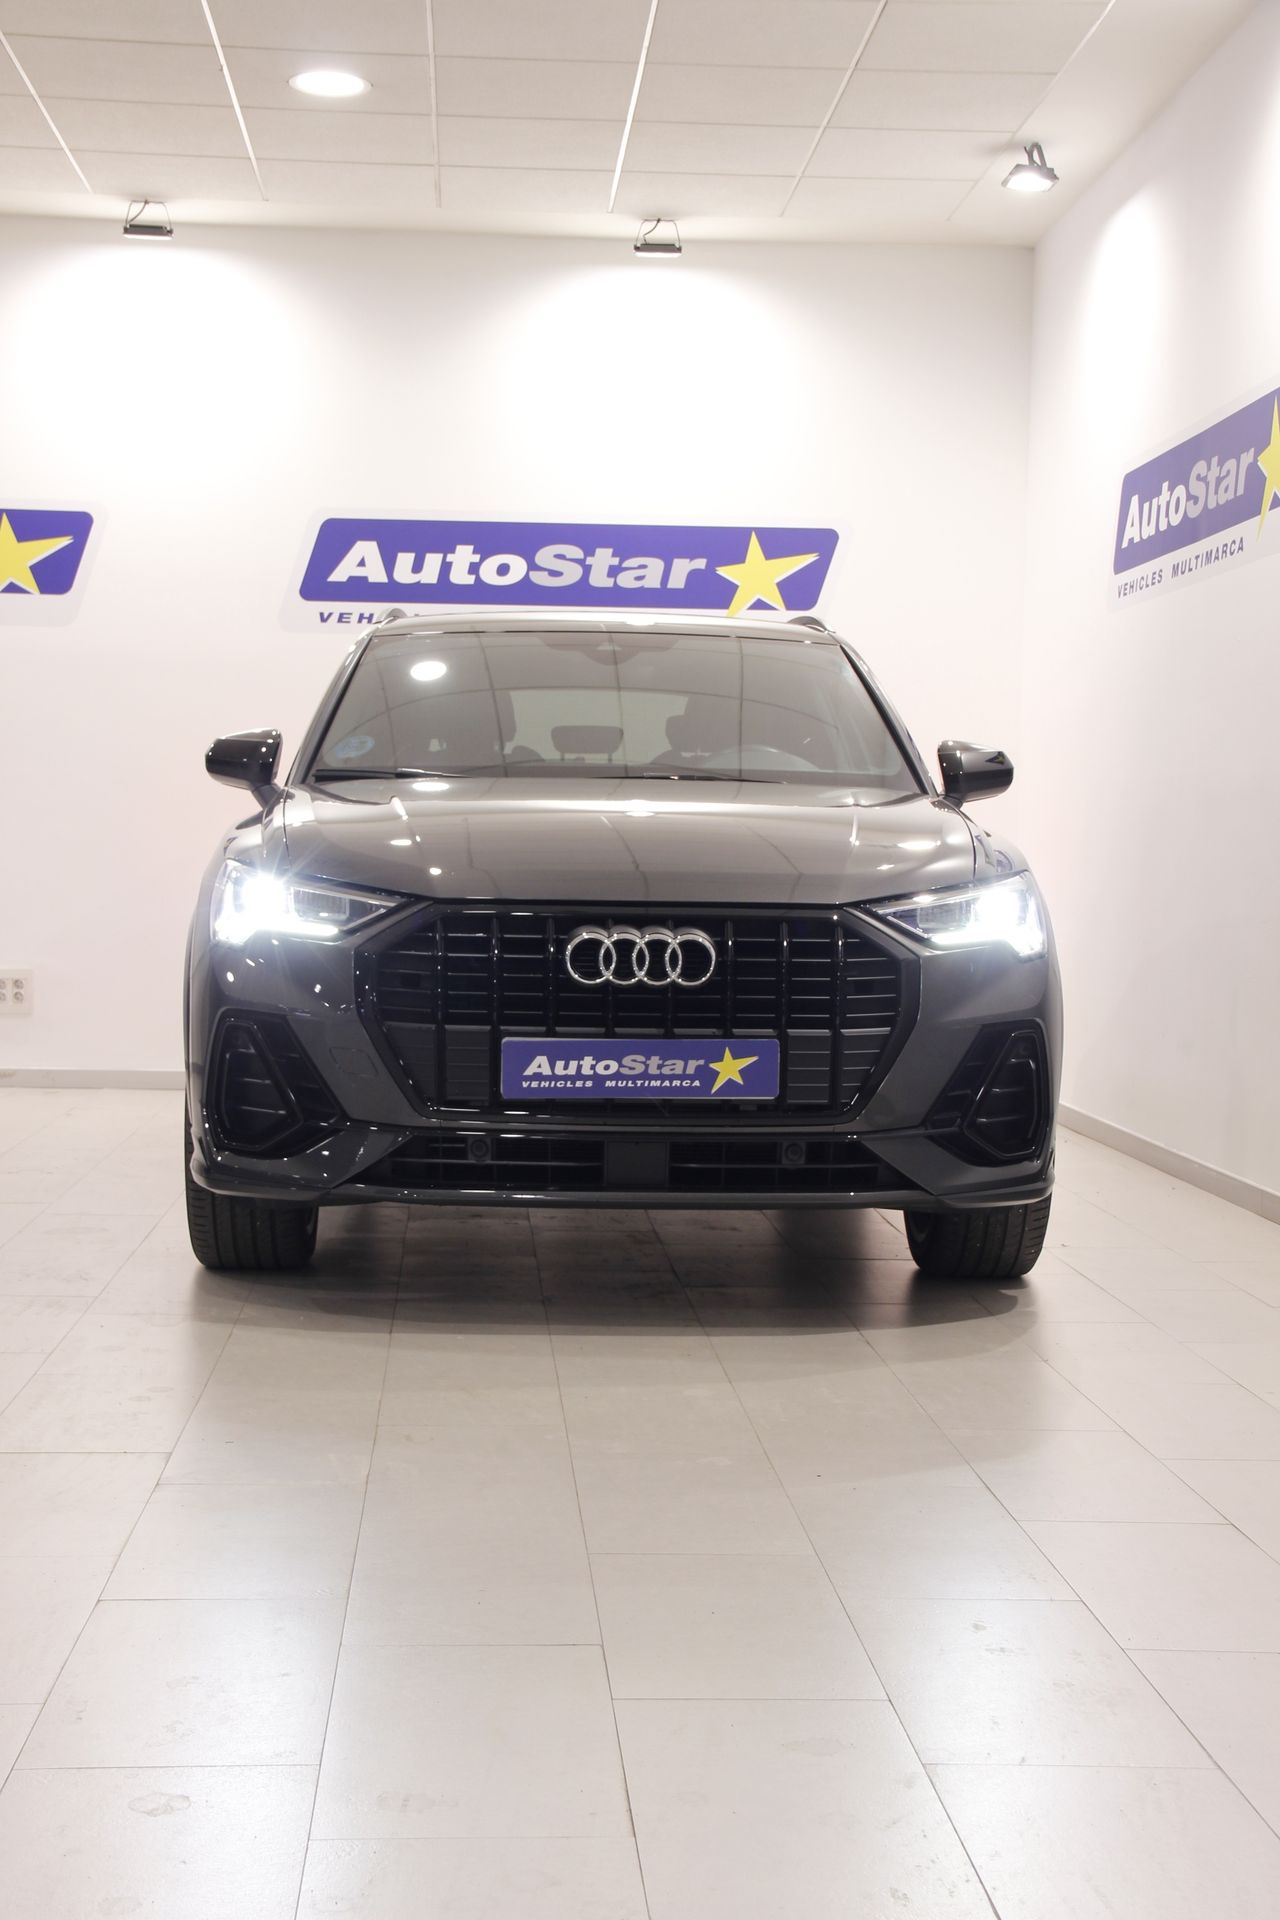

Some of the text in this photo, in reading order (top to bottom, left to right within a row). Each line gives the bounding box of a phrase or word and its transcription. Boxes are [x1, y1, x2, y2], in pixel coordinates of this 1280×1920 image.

[1121, 447, 1255, 549] AutoStar
[326, 540, 707, 589] AutoStar
[1117, 536, 1244, 599] VEHICLES MULTIMARCA
[521, 1079, 701, 1088] VEHICLES MULTIMARCA
[522, 1055, 704, 1076] AutoStar
